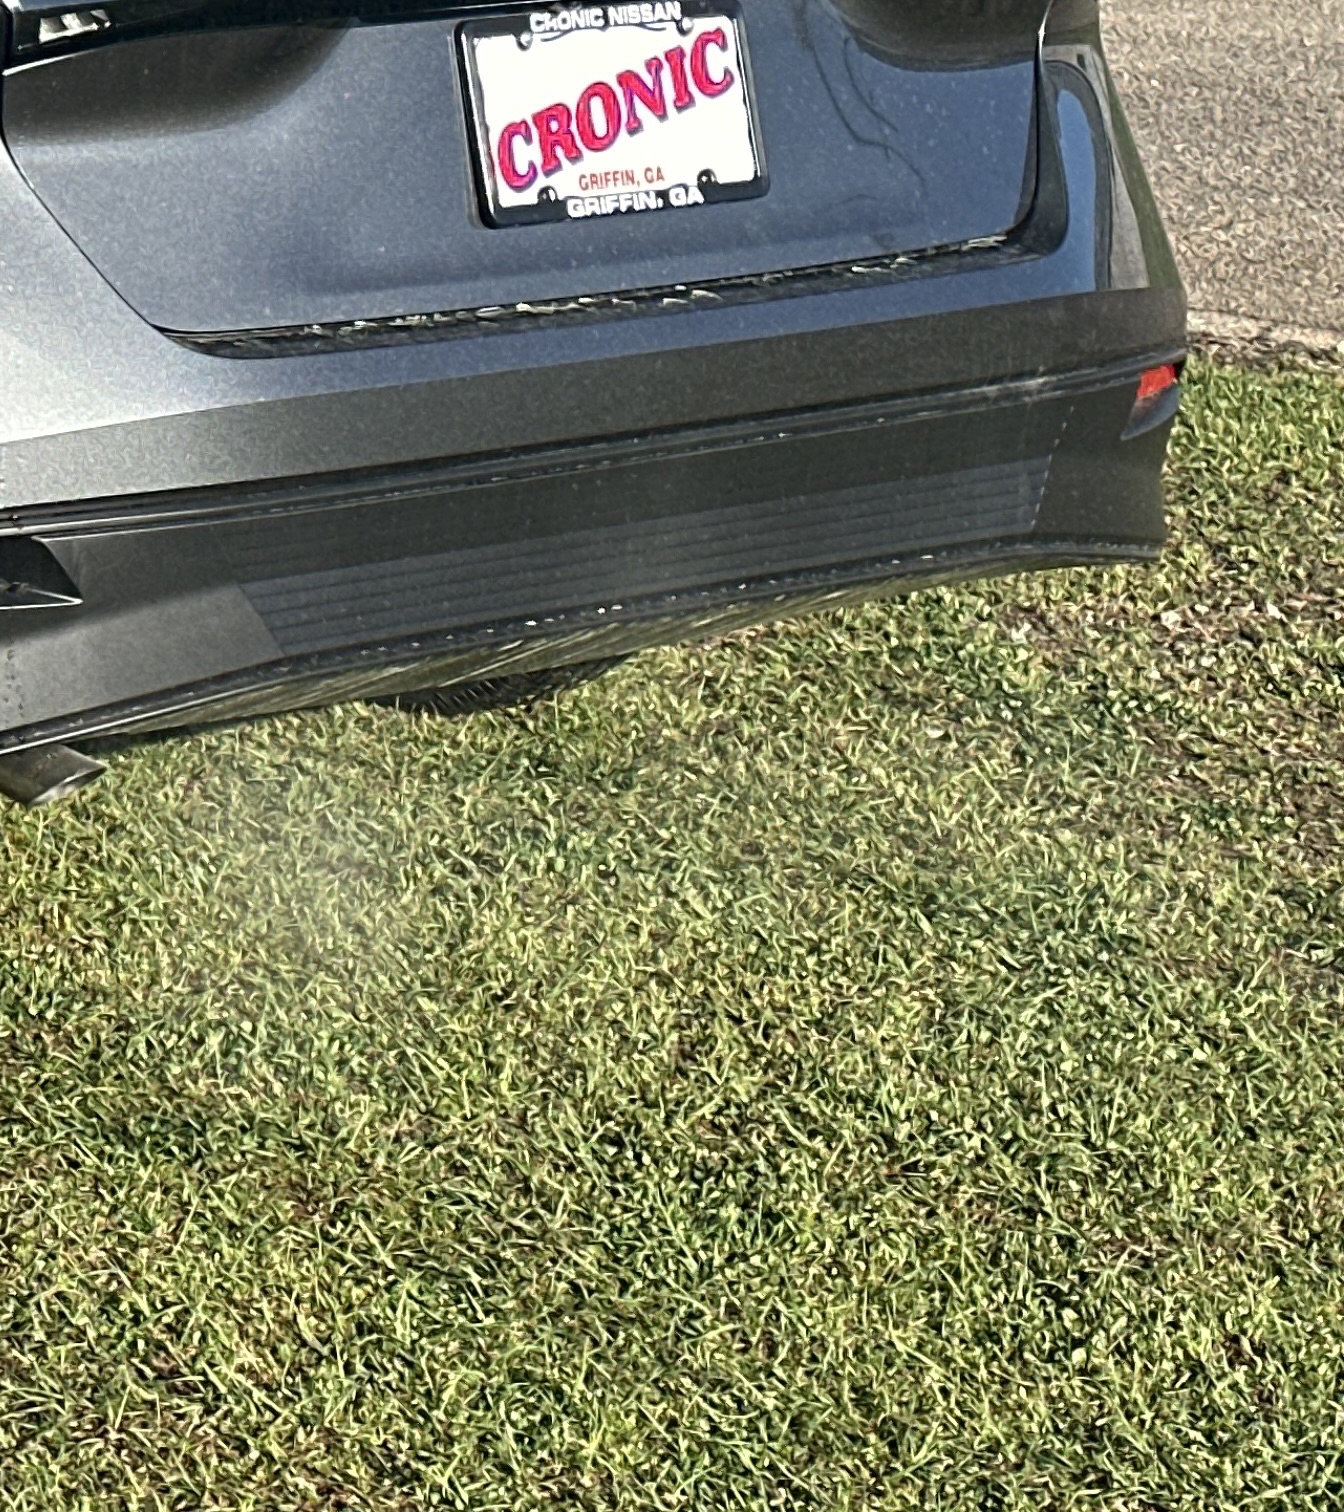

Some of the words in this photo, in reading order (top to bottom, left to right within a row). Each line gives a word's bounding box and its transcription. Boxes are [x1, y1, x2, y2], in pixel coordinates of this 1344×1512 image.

[607, 0, 682, 26] NISSAN
[498, 27, 735, 193] CRONIC
[578, 169, 641, 191] GRIFFIN,
[644, 166, 665, 184] GA
[668, 186, 705, 208] GA
